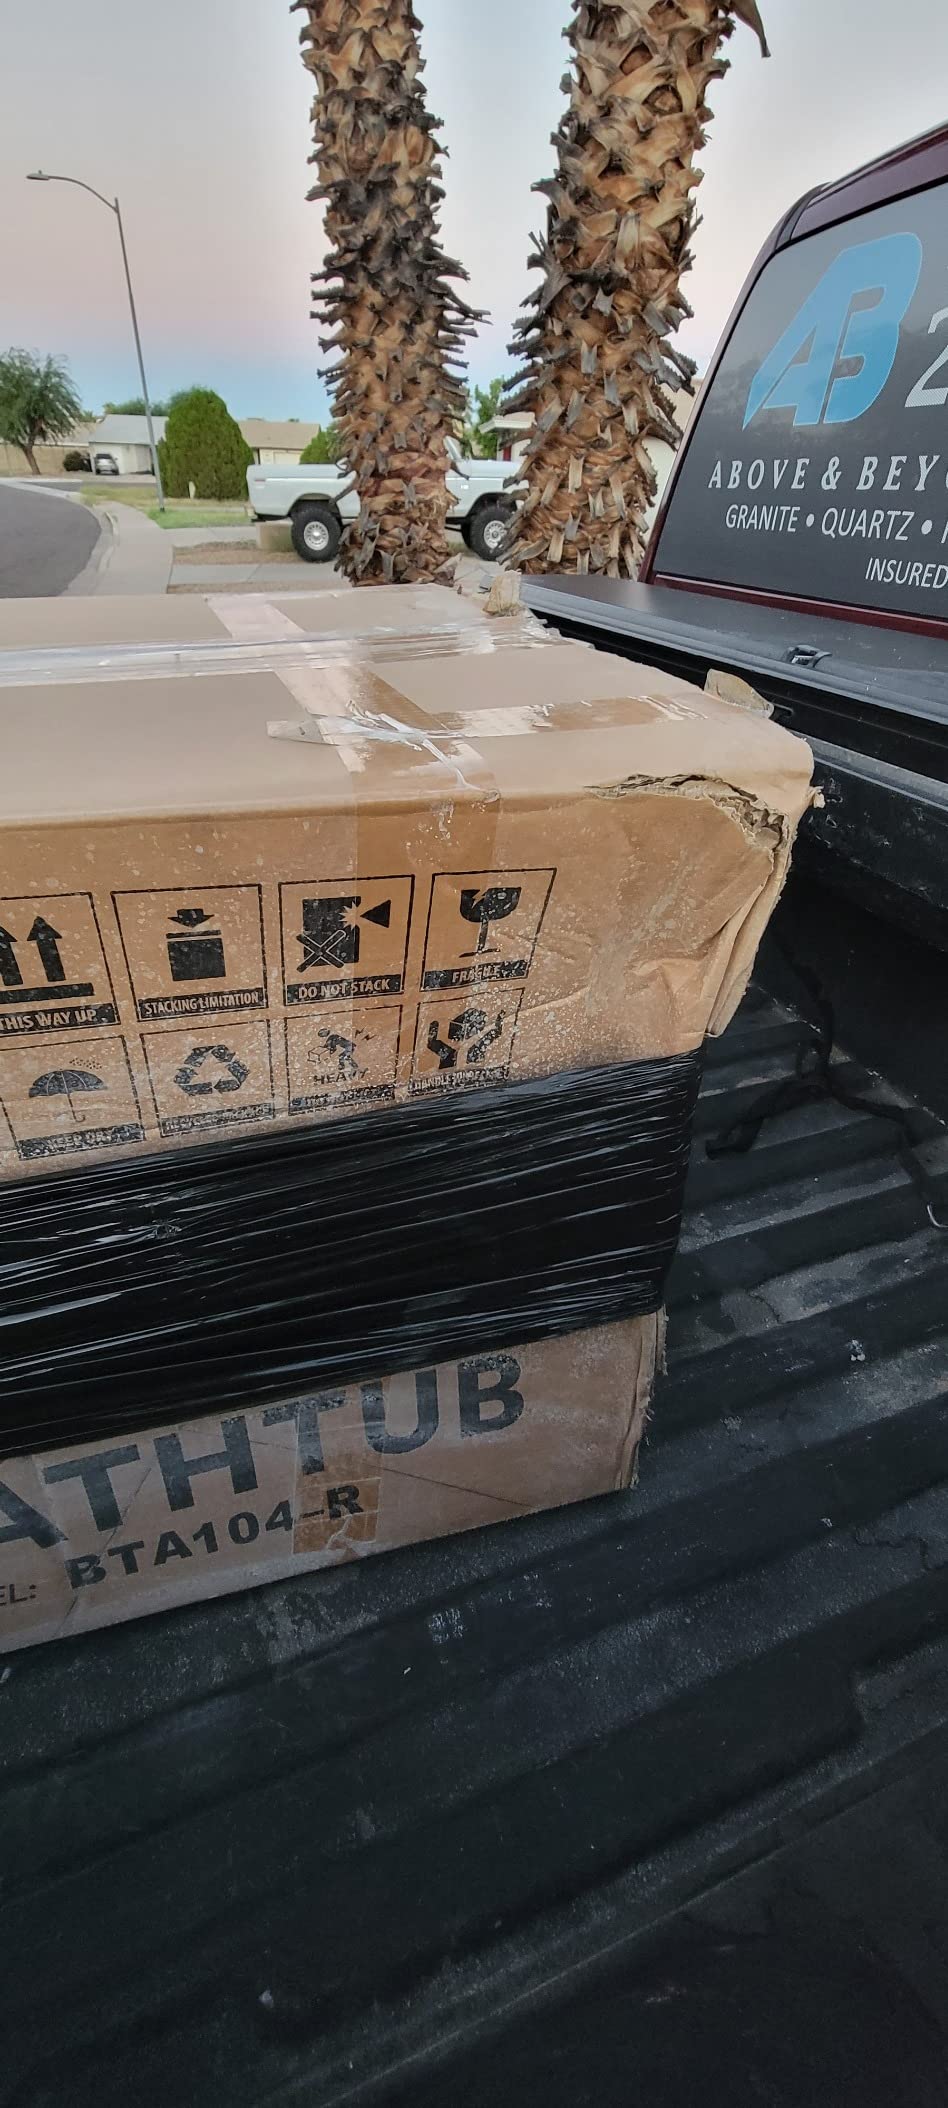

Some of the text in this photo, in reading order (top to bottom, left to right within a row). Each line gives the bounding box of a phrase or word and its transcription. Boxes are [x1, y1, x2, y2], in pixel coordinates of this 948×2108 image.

[708, 454, 948, 491] ABOVE & BEY
[725, 503, 801, 533] GRANITE
[820, 507, 915, 541] QUARTZ
[865, 556, 948, 589] INSURED
[452, 964, 501, 984] FRAGILE
[144, 991, 260, 1015] STACKING LIMITATION
[298, 978, 391, 1000] DO NOT STACK
[0, 1008, 97, 1031] THIS WAY UP
[65, 1484, 363, 1590] BTA104-R
